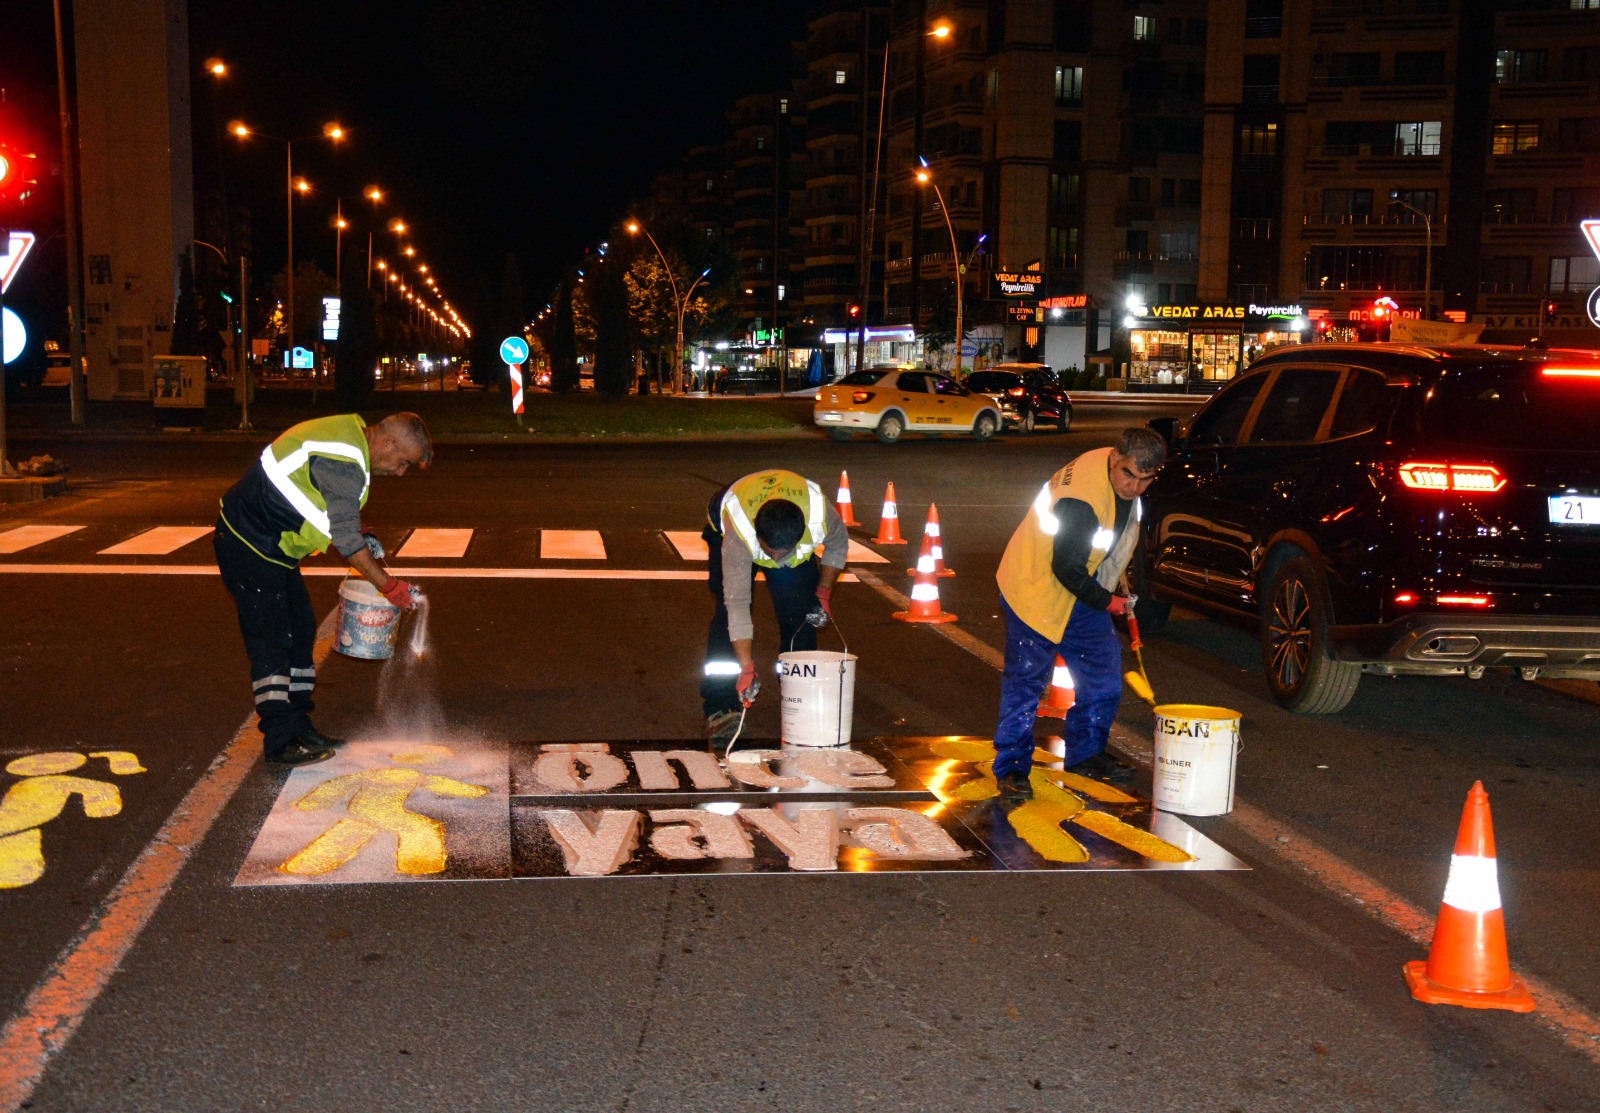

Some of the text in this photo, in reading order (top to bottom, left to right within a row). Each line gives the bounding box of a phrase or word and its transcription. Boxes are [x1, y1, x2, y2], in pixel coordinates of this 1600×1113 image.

[995, 273, 1041, 284] VEDAT ARAS
[1152, 306, 1199, 318] VEDAT
[1203, 306, 1244, 318] ARAS
[1564, 501, 1583, 520] 21
[1165, 759, 1192, 768] LINER
[541, 808, 976, 876] yaya
